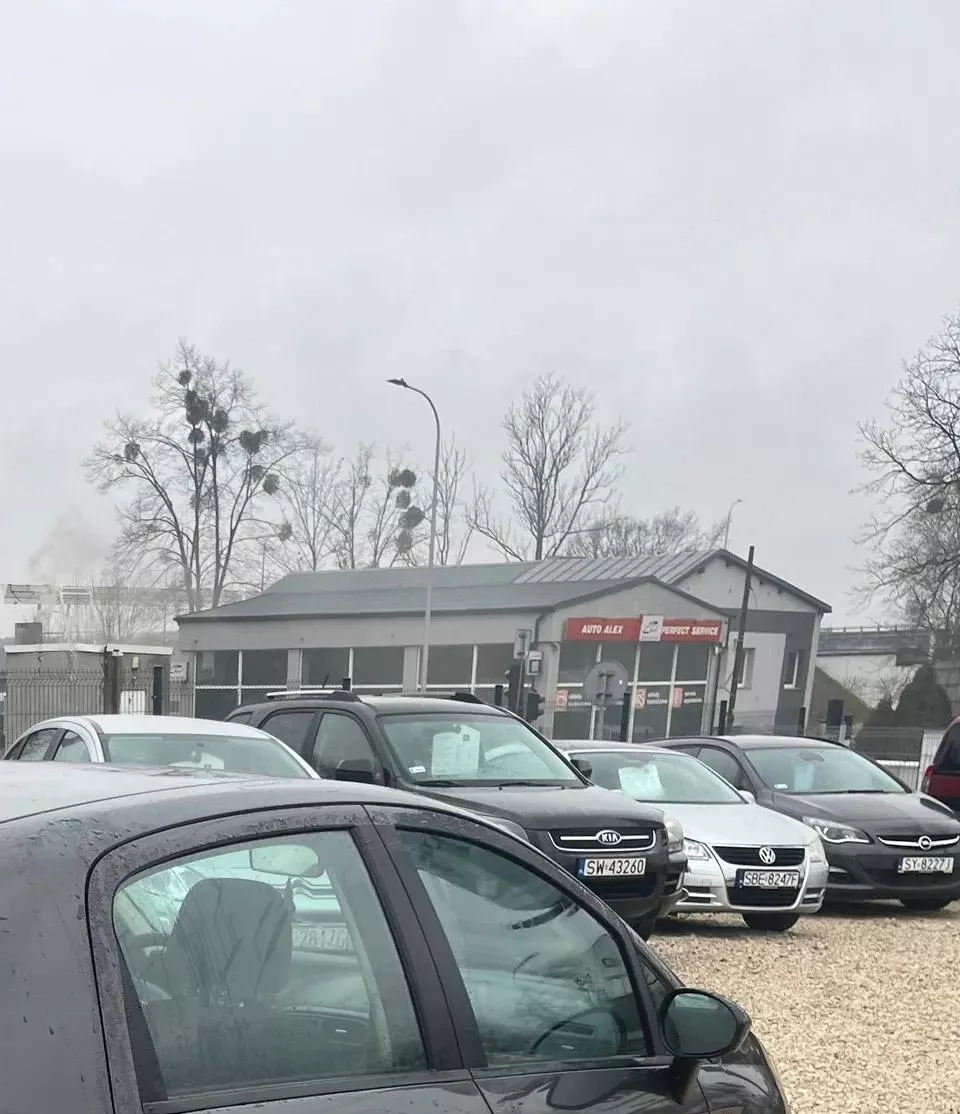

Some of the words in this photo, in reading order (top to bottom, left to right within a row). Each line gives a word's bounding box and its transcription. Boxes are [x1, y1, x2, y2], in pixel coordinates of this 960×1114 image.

[581, 624, 602, 634] AUTO
[603, 624, 624, 635] ALEX
[661, 626, 690, 636] PERFECT
[691, 626, 719, 636] SERVICE
[601, 833, 619, 843] KIA
[586, 860, 605, 875] SW
[608, 859, 644, 874] 43260
[904, 858, 918, 870] SY
[744, 872, 765, 886] SBE
[767, 873, 797, 886] 8247F
